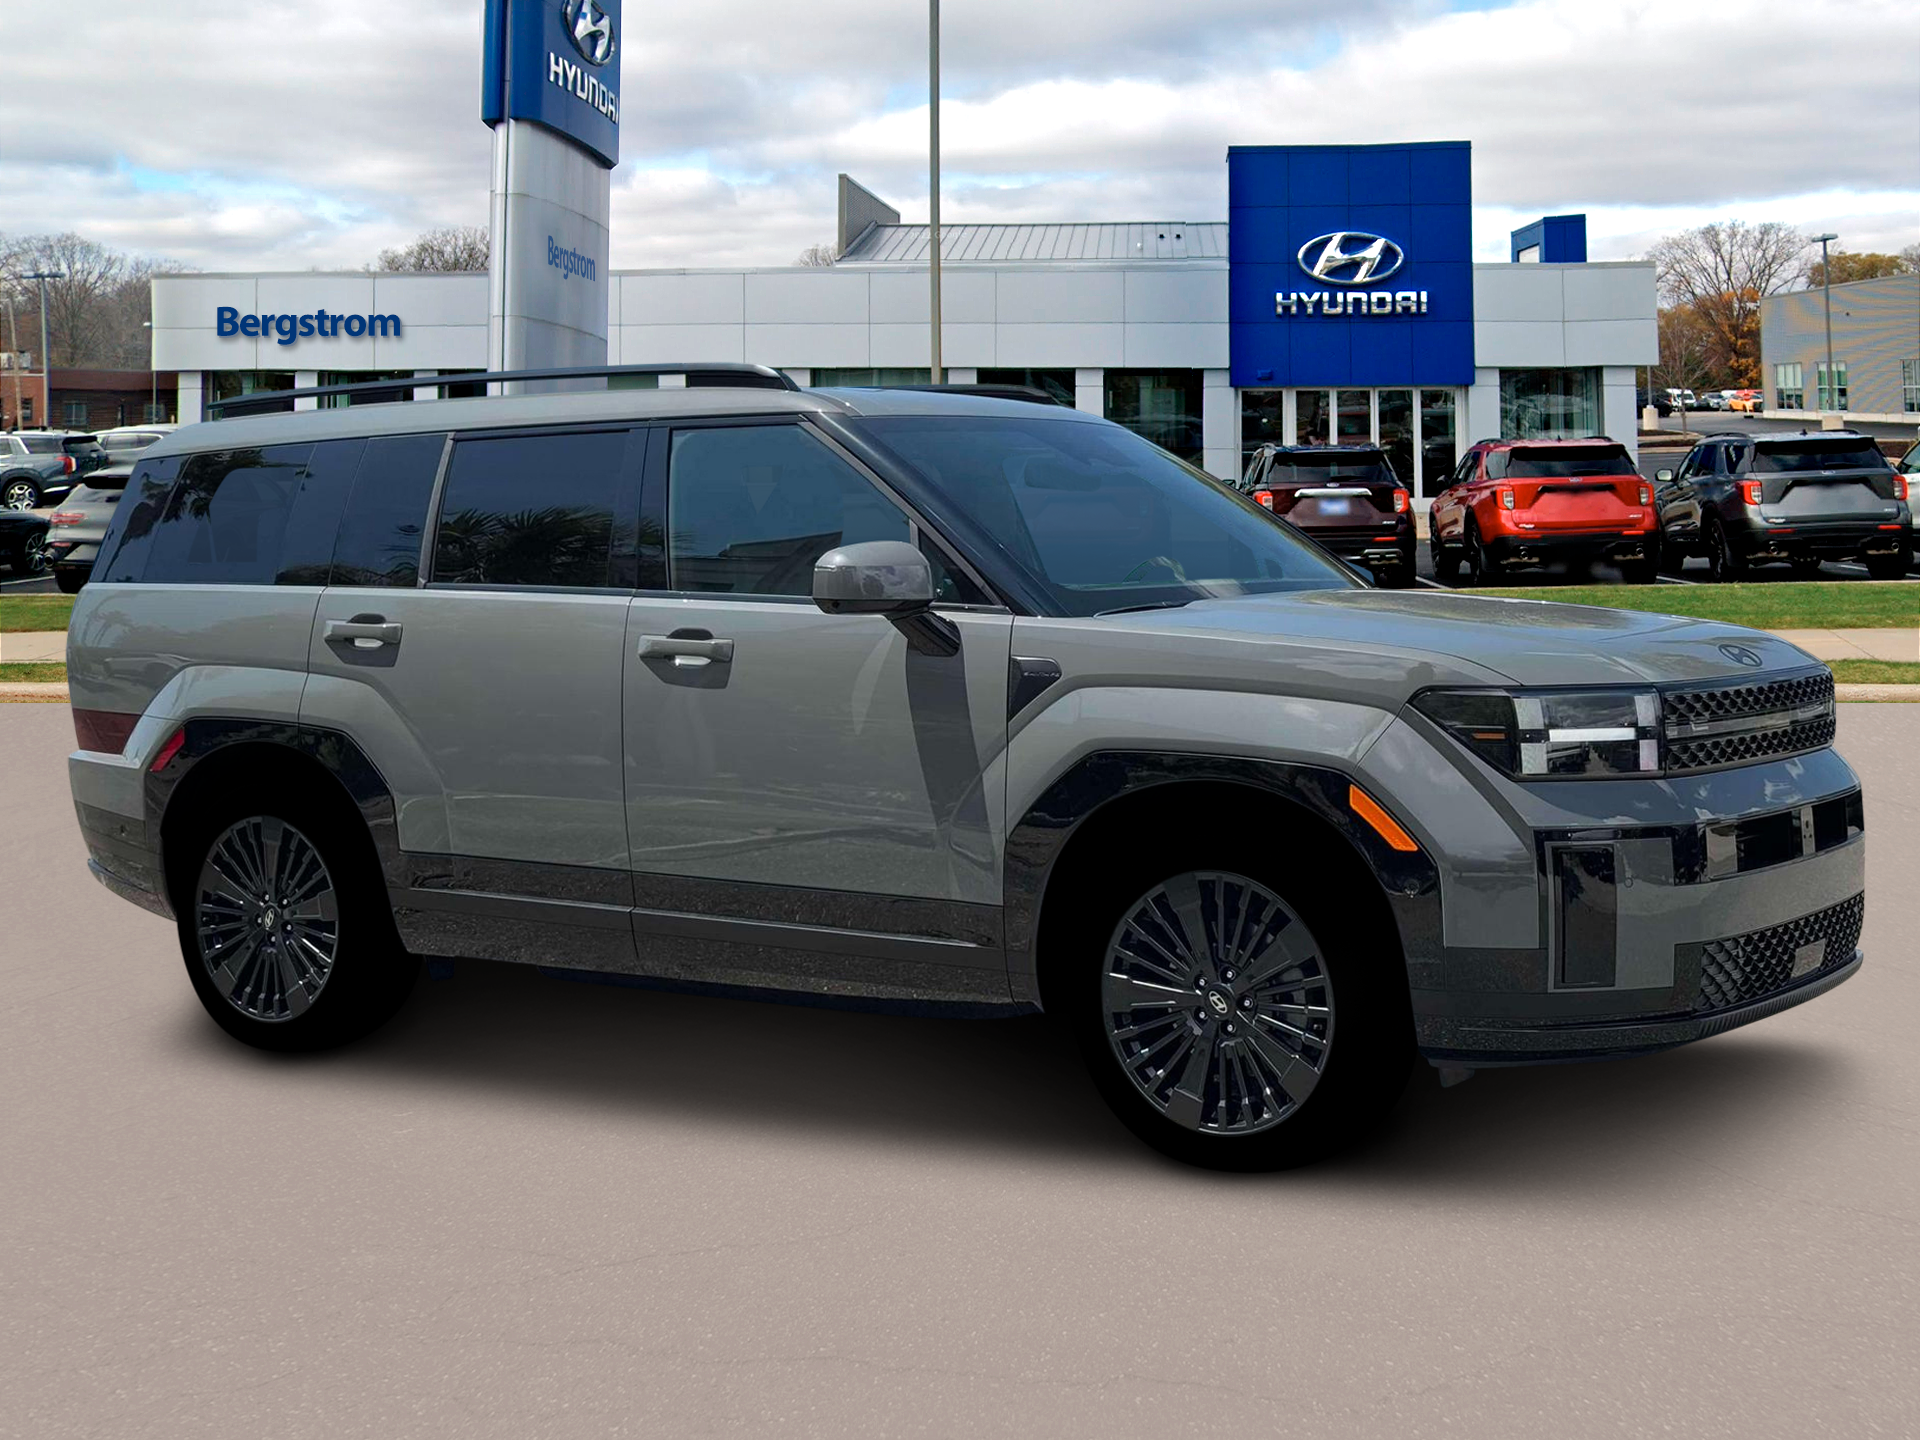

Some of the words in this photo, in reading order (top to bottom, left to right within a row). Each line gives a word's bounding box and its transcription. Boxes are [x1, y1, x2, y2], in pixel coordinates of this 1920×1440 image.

[549, 51, 619, 124] HYUNDAI
[547, 234, 596, 282] Bergstrom
[1275, 290, 1428, 315] HYUNDAI
[216, 306, 401, 346] Bergstrom
